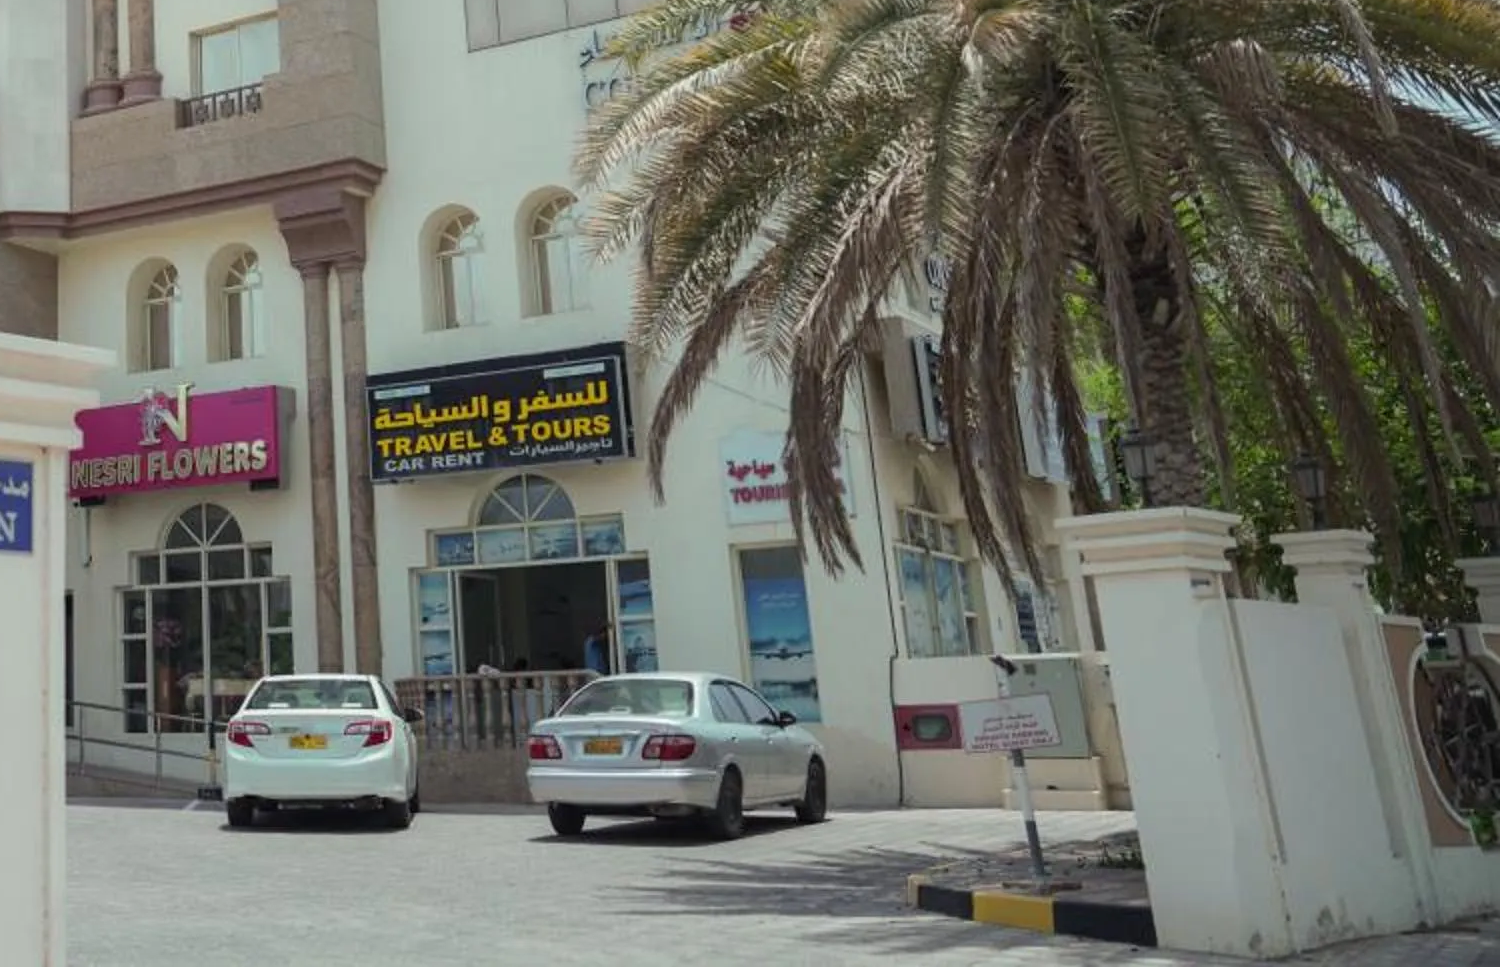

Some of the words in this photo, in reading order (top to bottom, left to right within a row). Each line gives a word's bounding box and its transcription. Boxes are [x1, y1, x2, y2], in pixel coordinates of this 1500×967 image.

[374, 394, 489, 430] السياحة
[492, 399, 512, 424] و
[517, 380, 608, 420] للسفر
[376, 429, 483, 458] TRAVEL
[487, 426, 508, 447] &
[511, 414, 612, 444] TOURS
[71, 453, 142, 489] NESRI
[147, 439, 268, 481] FLOWERS
[384, 456, 425, 473] CAR
[431, 451, 485, 468] RENT
[730, 482, 804, 504] TOURI
